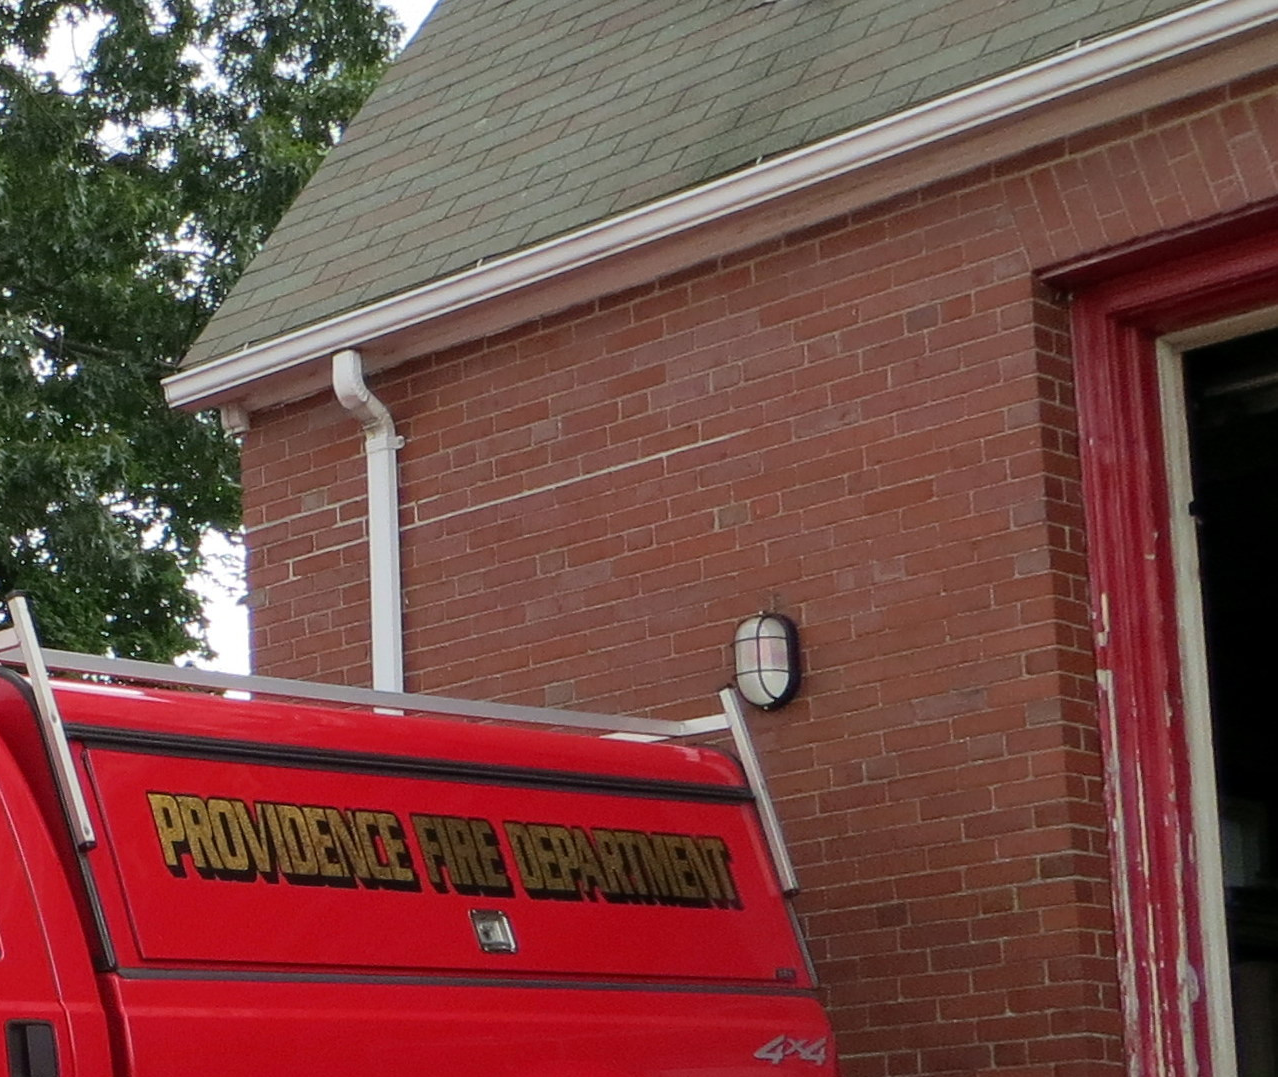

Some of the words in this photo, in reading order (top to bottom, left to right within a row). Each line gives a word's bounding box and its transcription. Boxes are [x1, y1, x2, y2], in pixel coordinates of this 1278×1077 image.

[146, 791, 422, 893] PROVIDENCE
[409, 812, 515, 898] FIRE
[503, 820, 744, 911] DEPARTMENT
